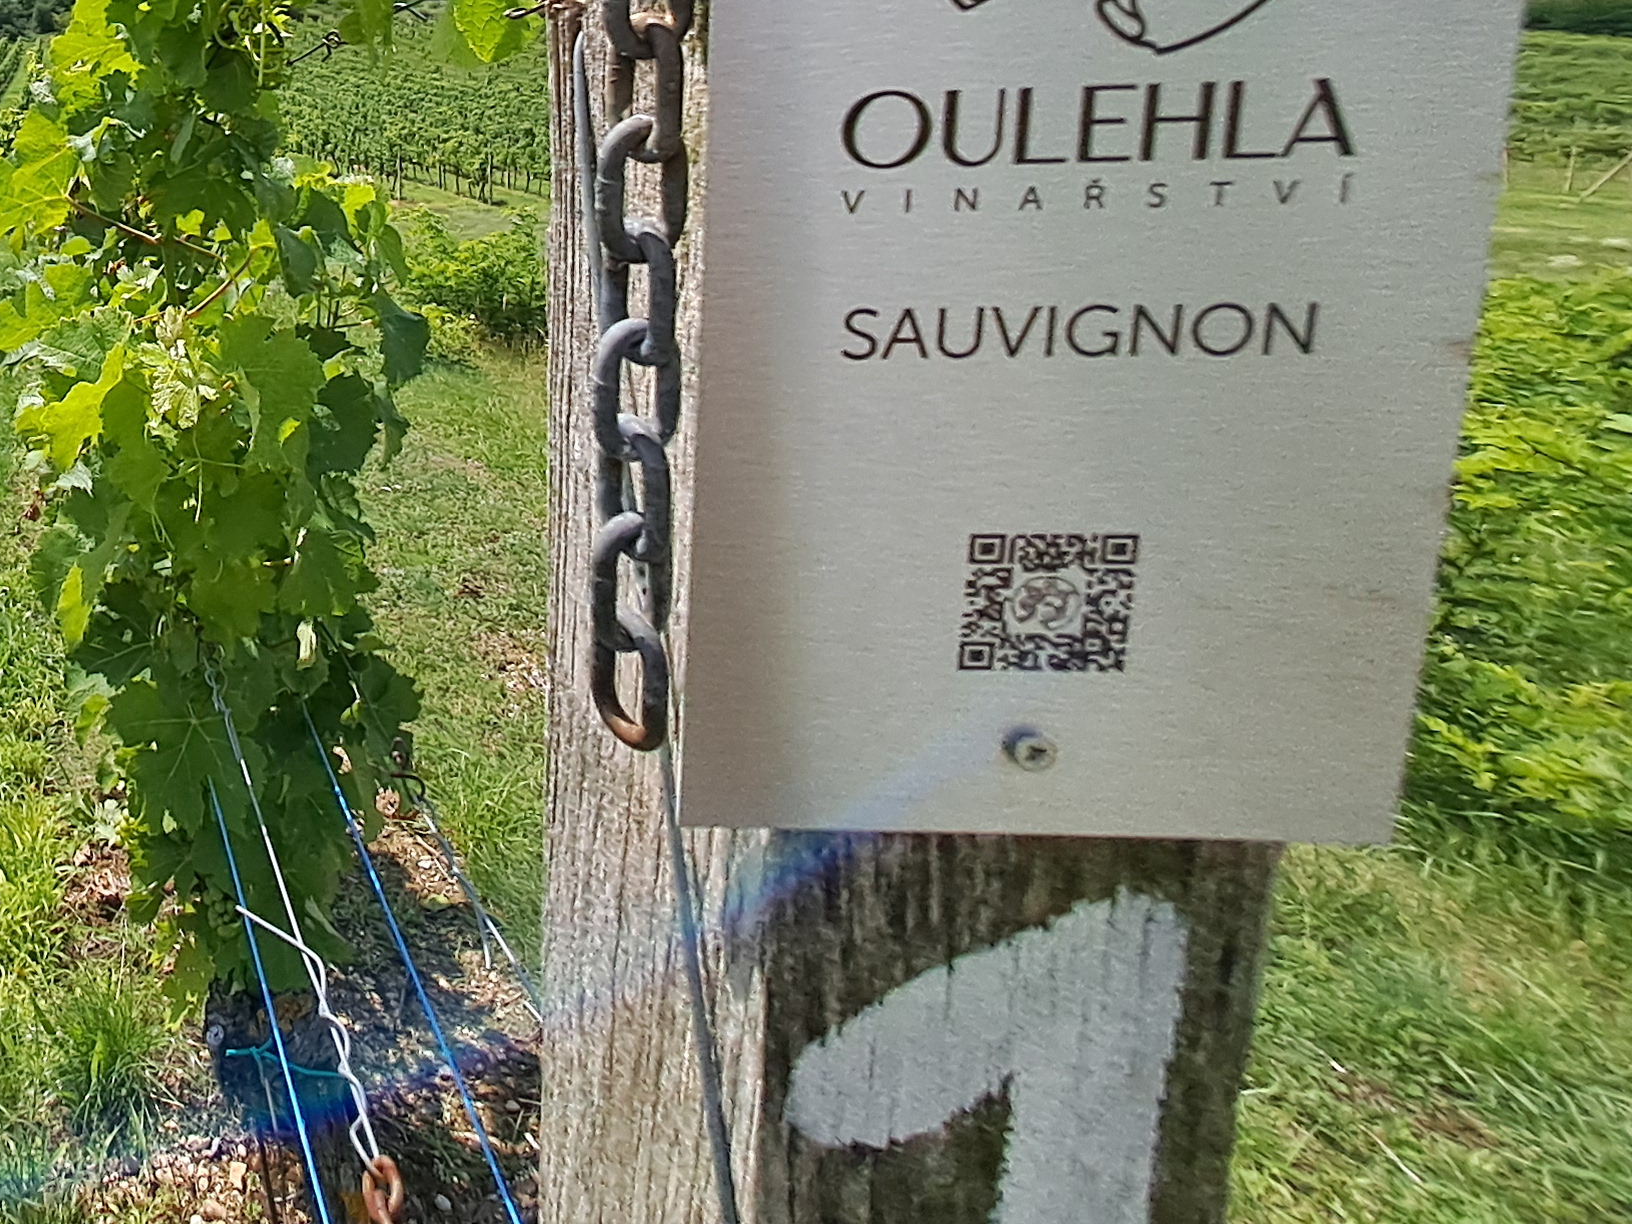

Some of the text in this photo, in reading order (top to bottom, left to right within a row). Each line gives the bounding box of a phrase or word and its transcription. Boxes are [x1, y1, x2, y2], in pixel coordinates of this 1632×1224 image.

[840, 77, 1357, 170] OULEHLA
[841, 172, 1357, 215] VINAŘSTVÍ
[840, 300, 1321, 361] SAUVIGNON
